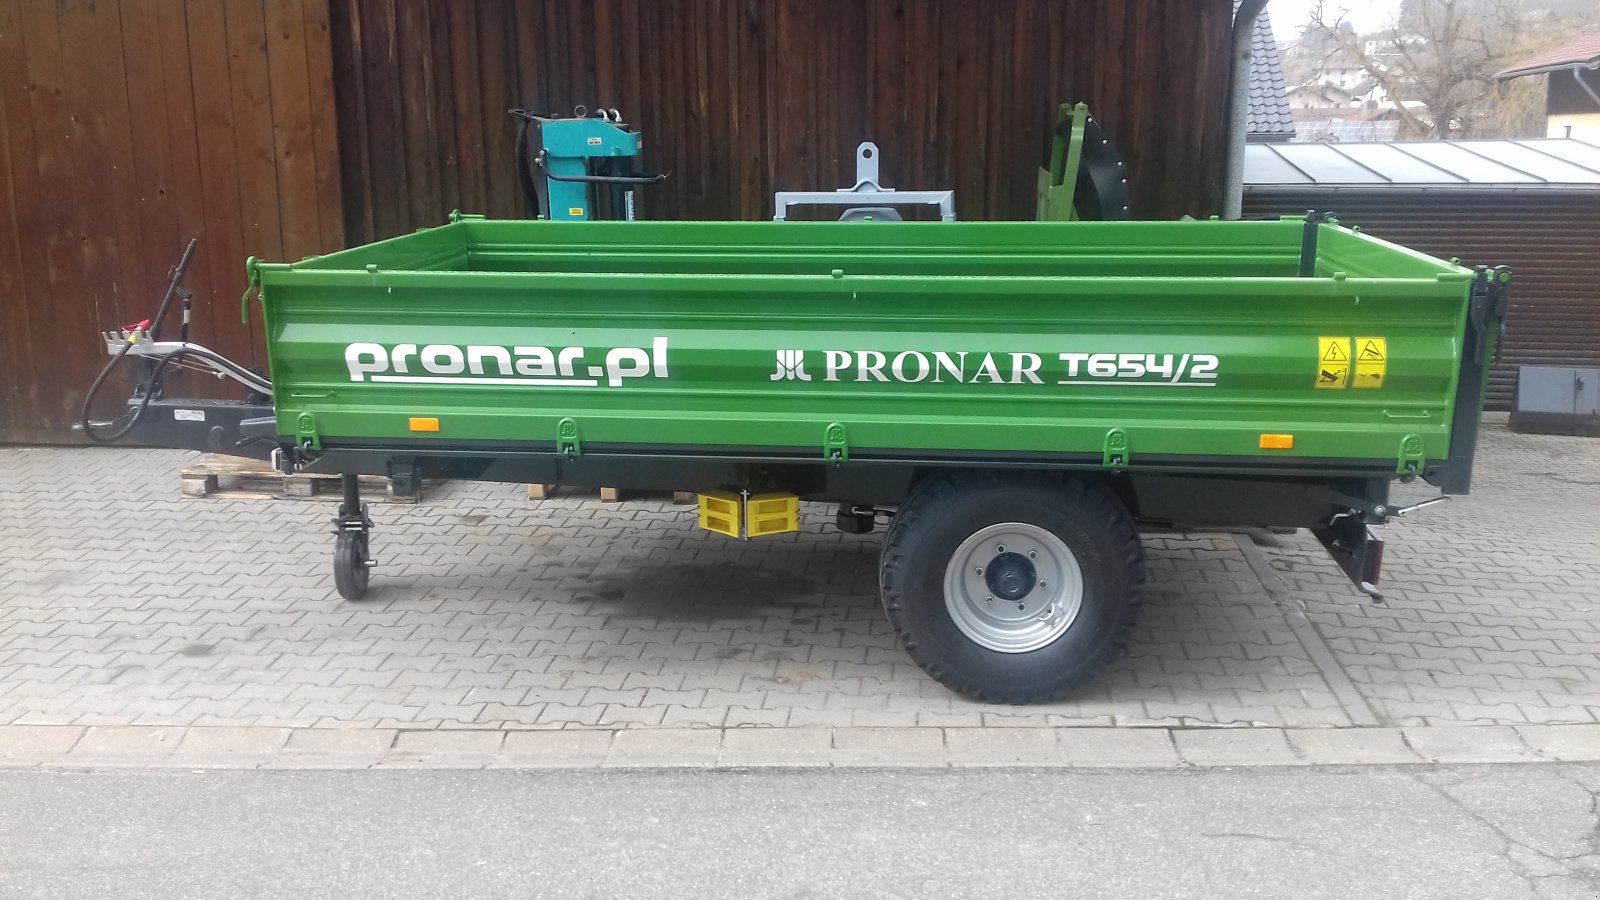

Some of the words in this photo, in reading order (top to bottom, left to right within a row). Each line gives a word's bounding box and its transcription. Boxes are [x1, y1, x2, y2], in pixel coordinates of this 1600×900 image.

[344, 336, 669, 387] pronar.pl
[822, 350, 1045, 385] PRONAR
[1058, 353, 1220, 383] T654/2
